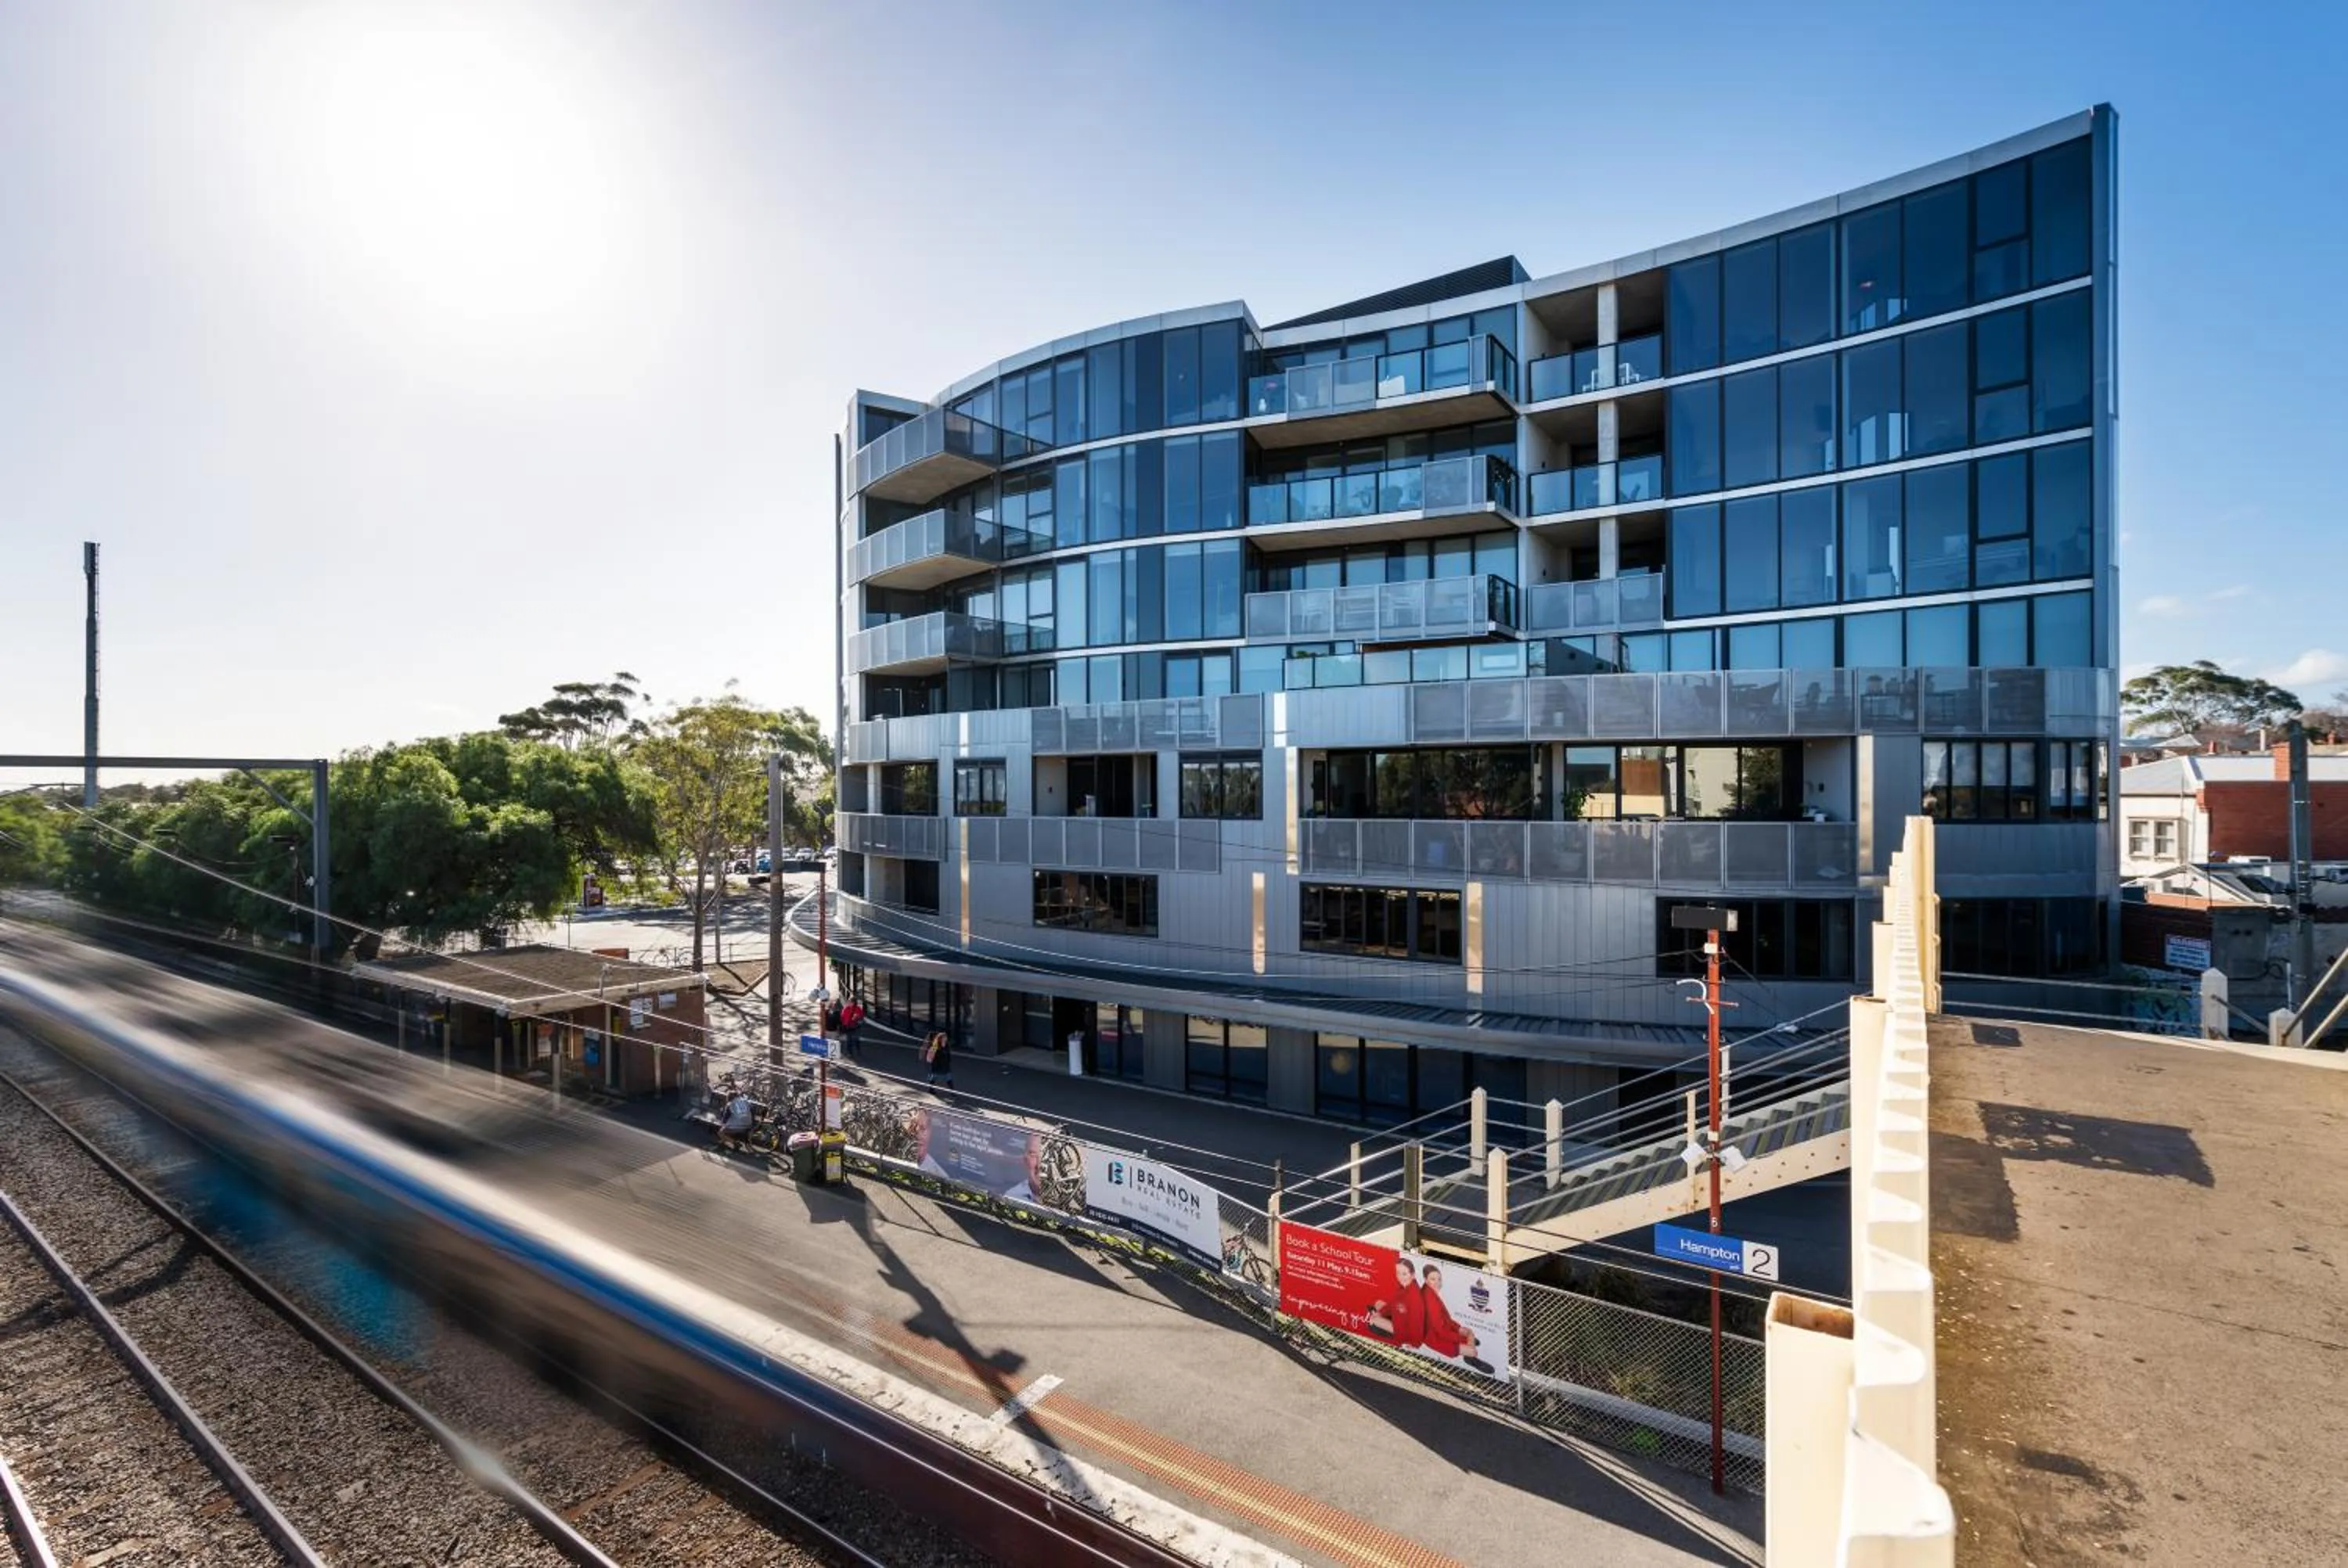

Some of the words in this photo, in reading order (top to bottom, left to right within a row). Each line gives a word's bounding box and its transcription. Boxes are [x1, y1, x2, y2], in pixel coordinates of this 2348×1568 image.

[830, 1042, 837, 1056] 2
[1137, 1169, 1200, 1209] BRANON
[1137, 1185, 1161, 1201] REAL
[1165, 1199, 1201, 1220] ESTATE
[1286, 1234, 1310, 1250] Book
[1320, 1243, 1352, 1260] School
[1353, 1251, 1375, 1265] Tour
[1680, 1239, 1740, 1262] Hampton
[1752, 1248, 1771, 1276] 2
